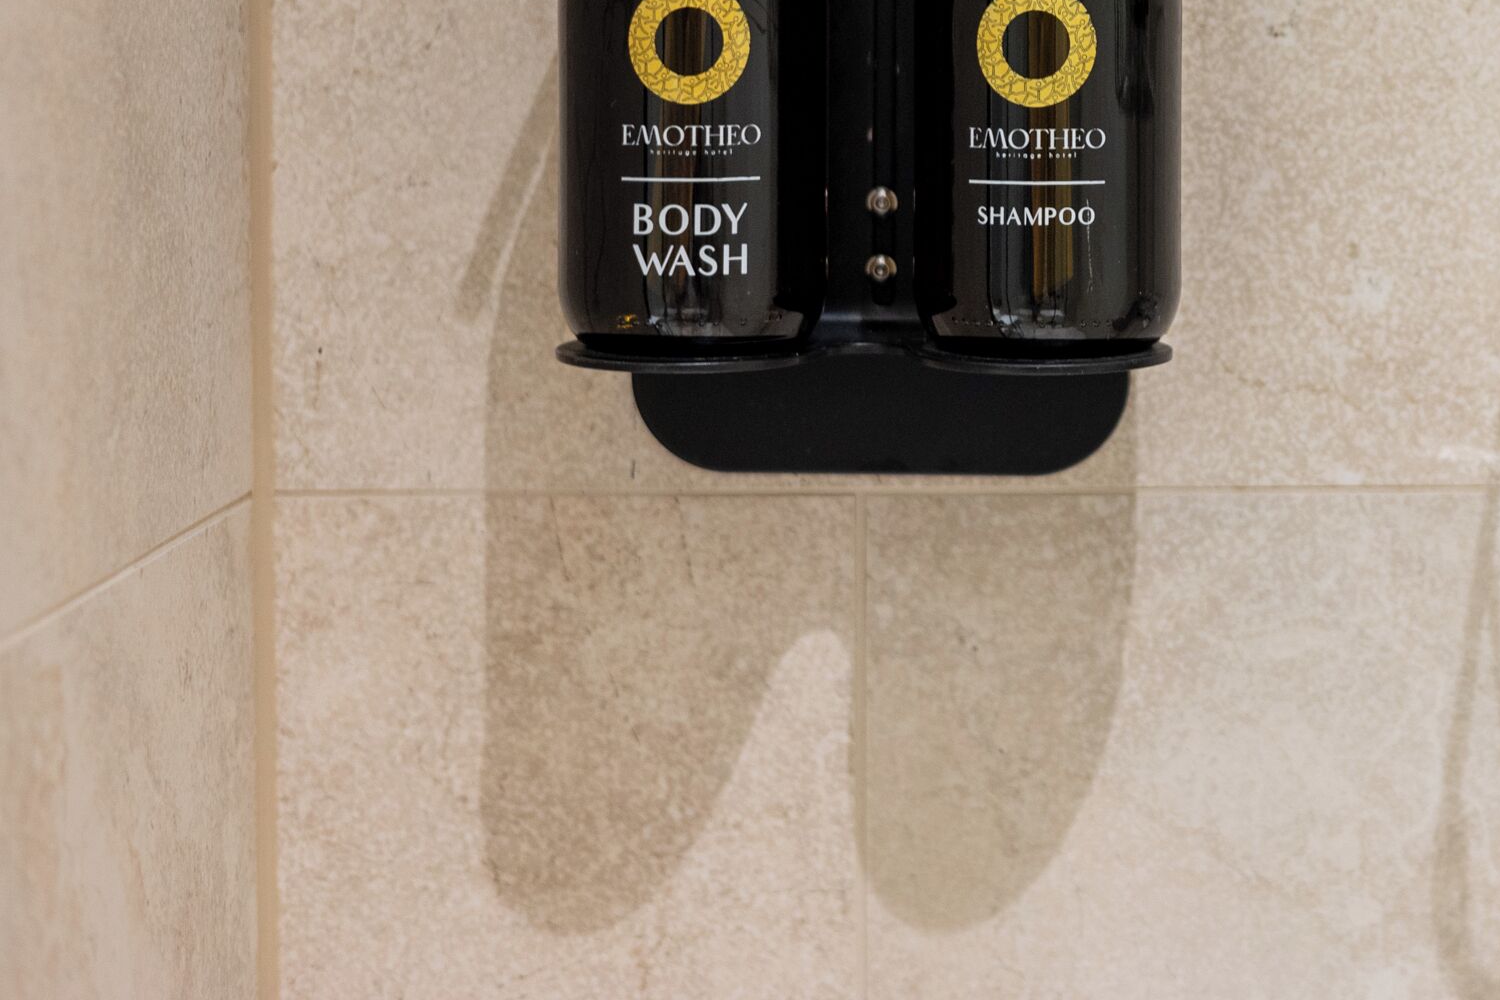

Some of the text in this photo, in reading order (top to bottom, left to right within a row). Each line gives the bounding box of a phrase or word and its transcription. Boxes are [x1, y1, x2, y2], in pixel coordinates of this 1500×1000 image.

[621, 123, 761, 144] EMOTHEO
[969, 127, 1106, 150] EMOTHEO
[996, 151, 1077, 160] heritage hotel
[633, 202, 748, 236] BODY
[977, 206, 1096, 226] SHAMPOO
[632, 243, 748, 277] WASH
